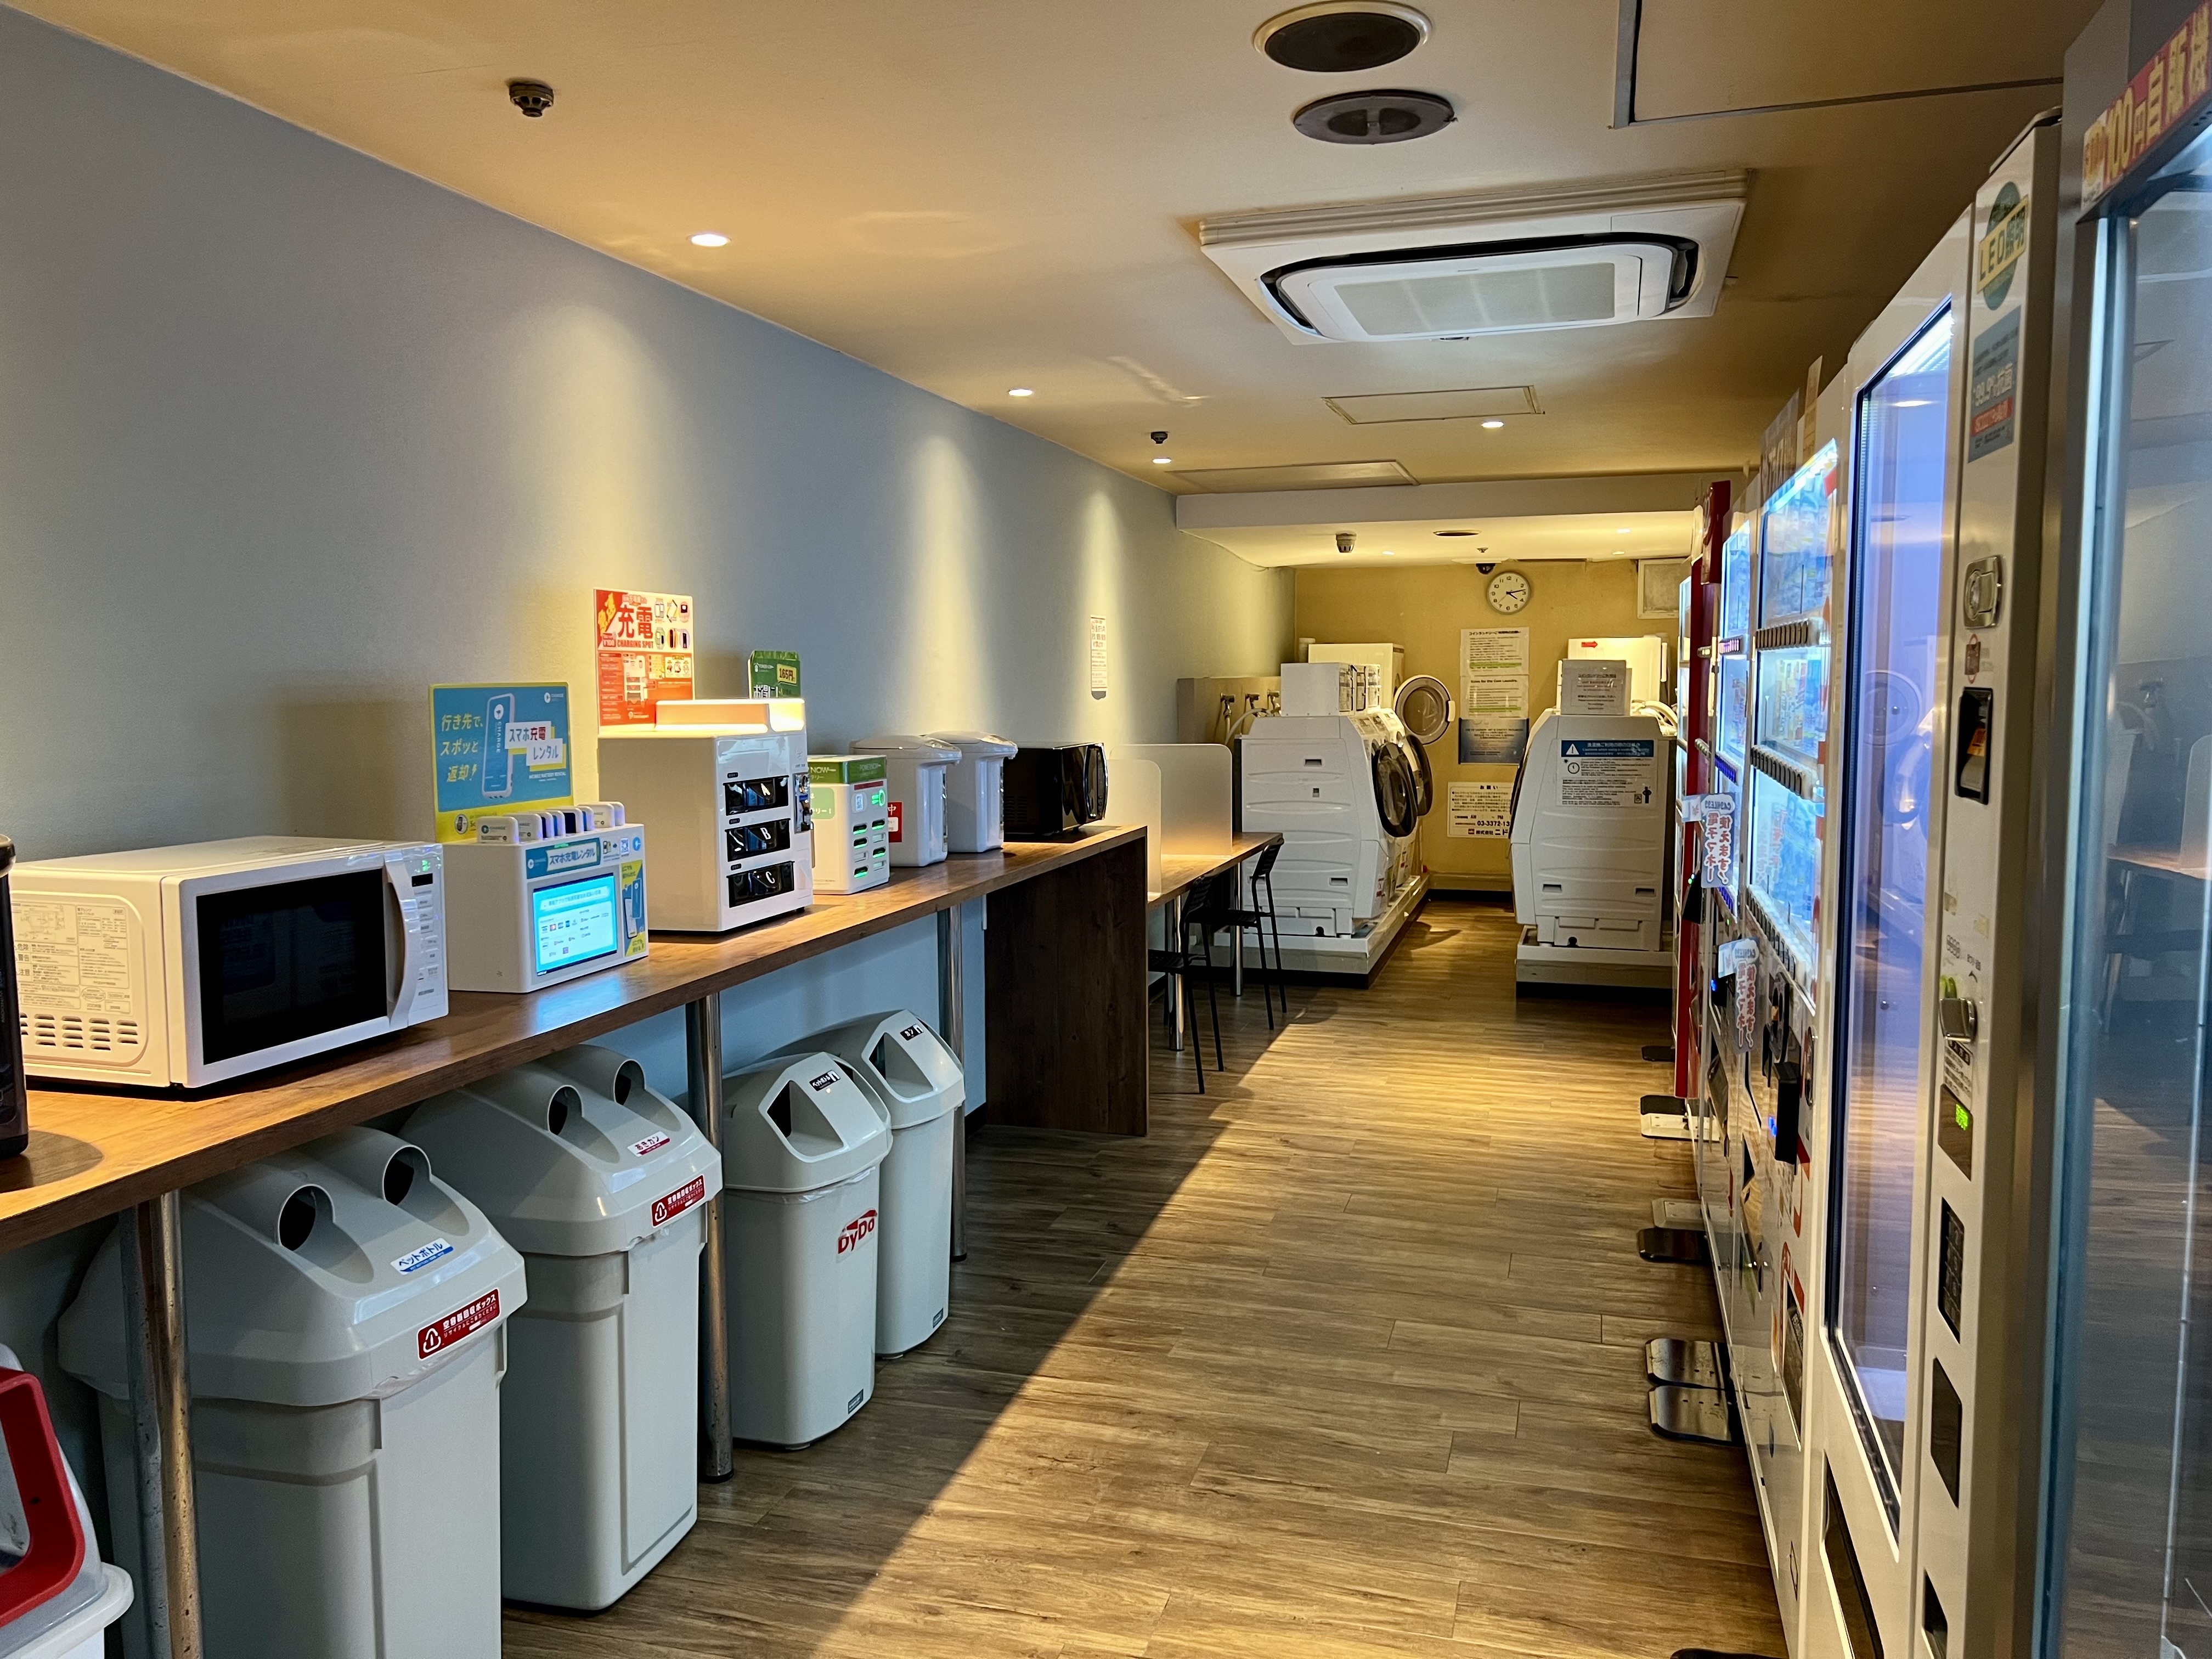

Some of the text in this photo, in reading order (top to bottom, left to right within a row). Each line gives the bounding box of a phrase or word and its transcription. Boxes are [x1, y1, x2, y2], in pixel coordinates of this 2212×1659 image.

[618, 604, 653, 639] 充電
[617, 640, 641, 648] CHARGING
[779, 668, 793, 681] 165円
[442, 713, 483, 731] 行き先で、
[509, 726, 546, 742] スマホ充電
[440, 738, 478, 756] スポッと
[533, 745, 559, 760] レンタル
[760, 783, 771, 795] A
[760, 827, 771, 840] B
[550, 848, 596, 865] スマホ充電レンタル
[765, 871, 776, 884] C
[635, 1136, 659, 1150] あきカン
[838, 1217, 874, 1254] DyDo
[399, 1243, 443, 1266] ペットボトル
